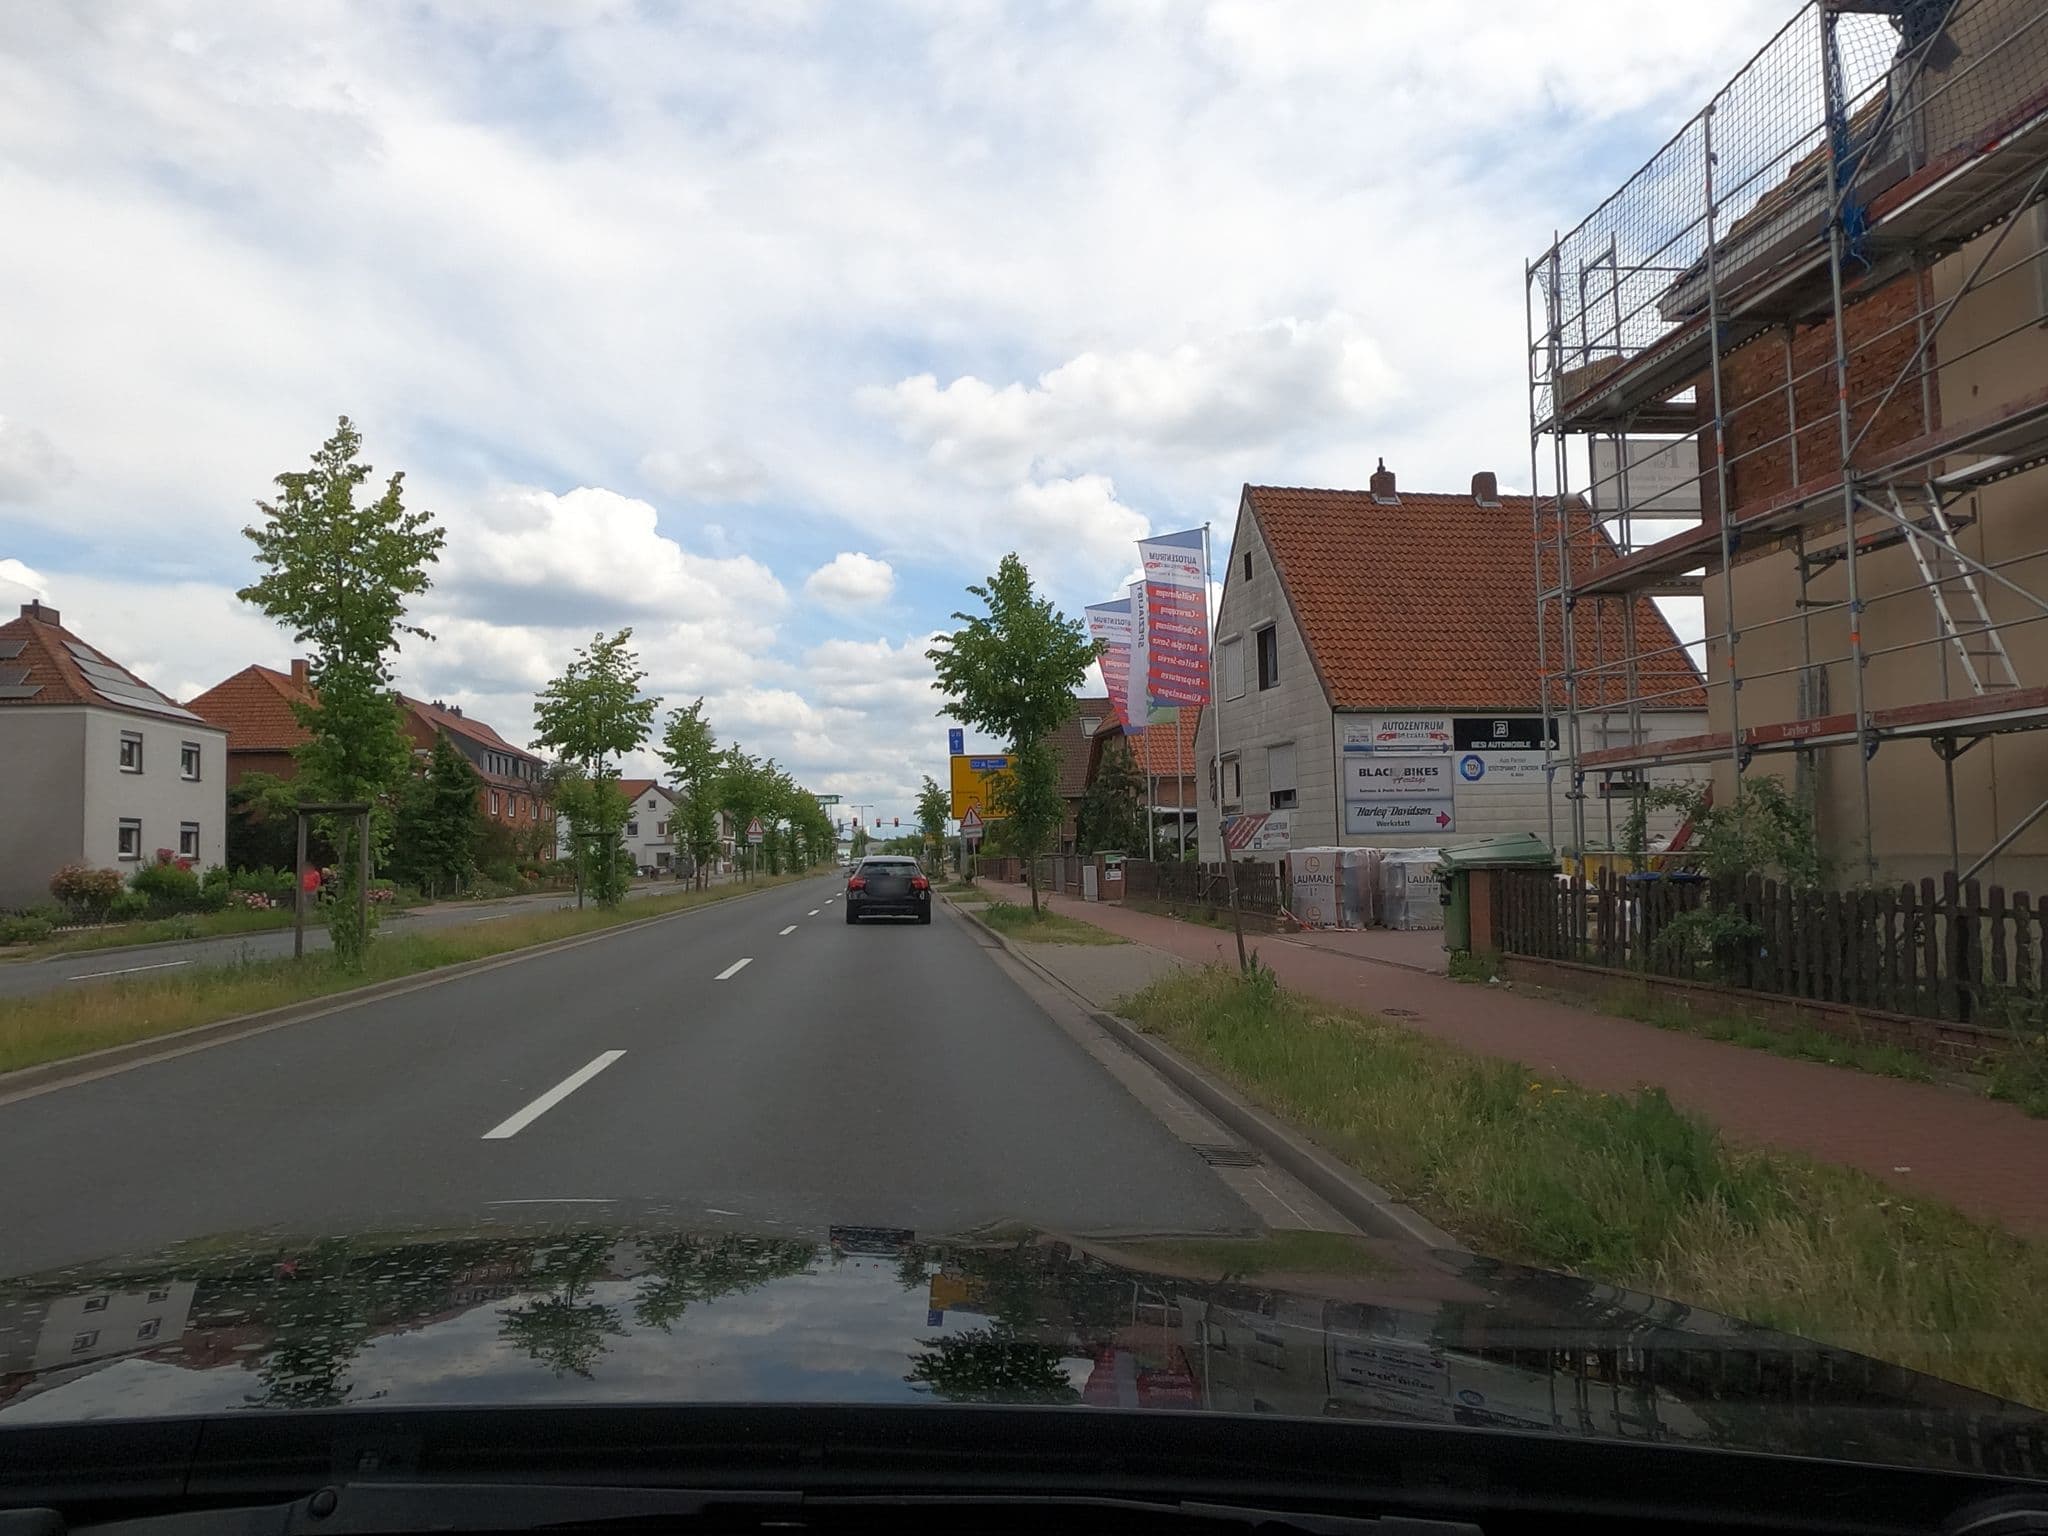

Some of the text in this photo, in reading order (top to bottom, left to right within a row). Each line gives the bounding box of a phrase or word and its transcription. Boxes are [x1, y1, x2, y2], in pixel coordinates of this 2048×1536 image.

[1382, 721, 1444, 731] AUTOZENTRUM
[1404, 767, 1439, 776] BIKES
[1293, 874, 1334, 884] LAUMANS
